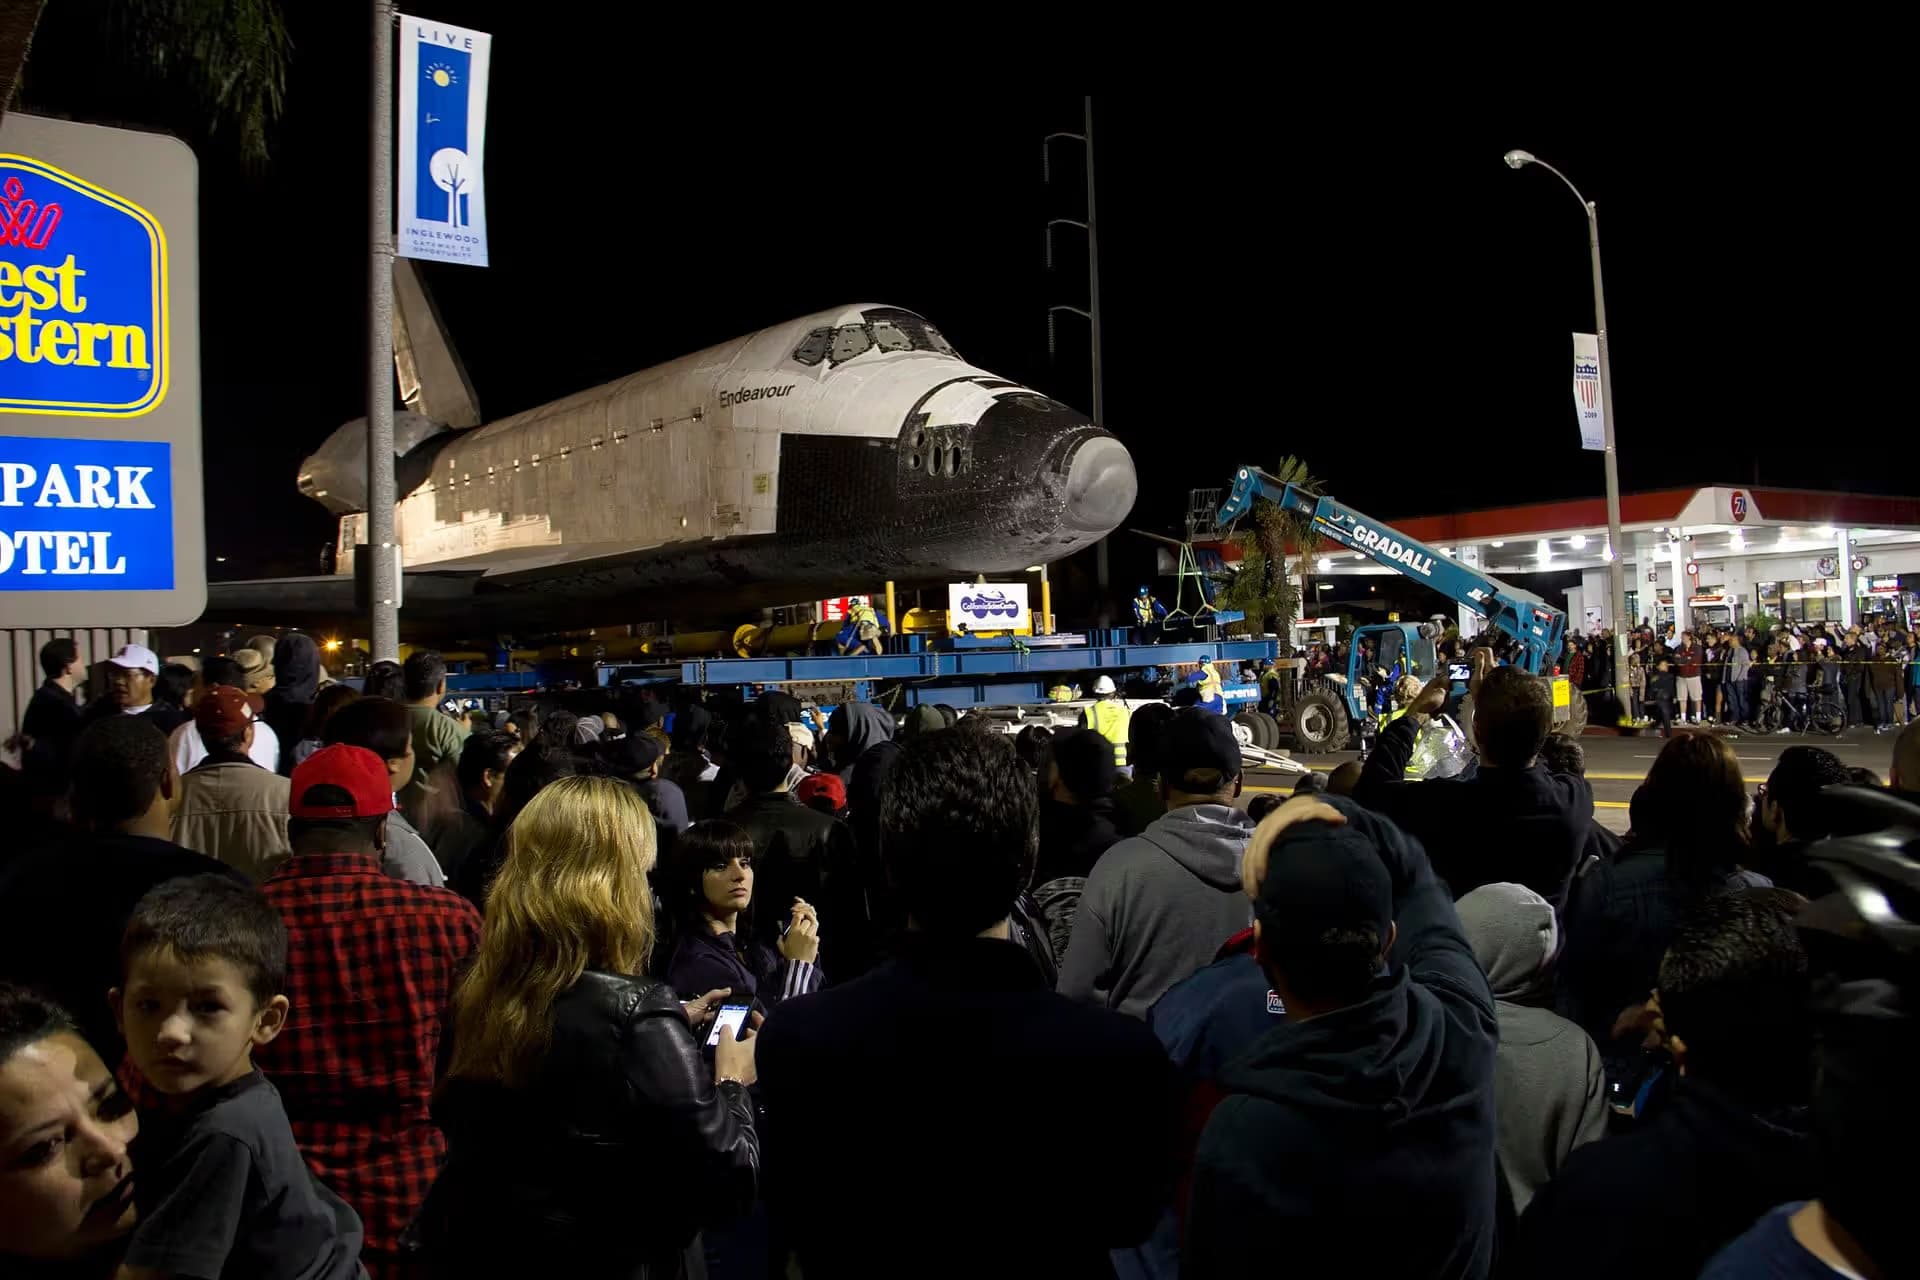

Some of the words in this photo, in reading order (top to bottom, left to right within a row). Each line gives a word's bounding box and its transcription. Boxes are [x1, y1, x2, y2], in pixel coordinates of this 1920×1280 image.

[417, 26, 472, 49] LIVE
[406, 228, 480, 244] INGLEWOOD
[719, 384, 796, 408] Endeavour
[0, 462, 156, 509] PARK
[1352, 524, 1433, 577] GRADALL
